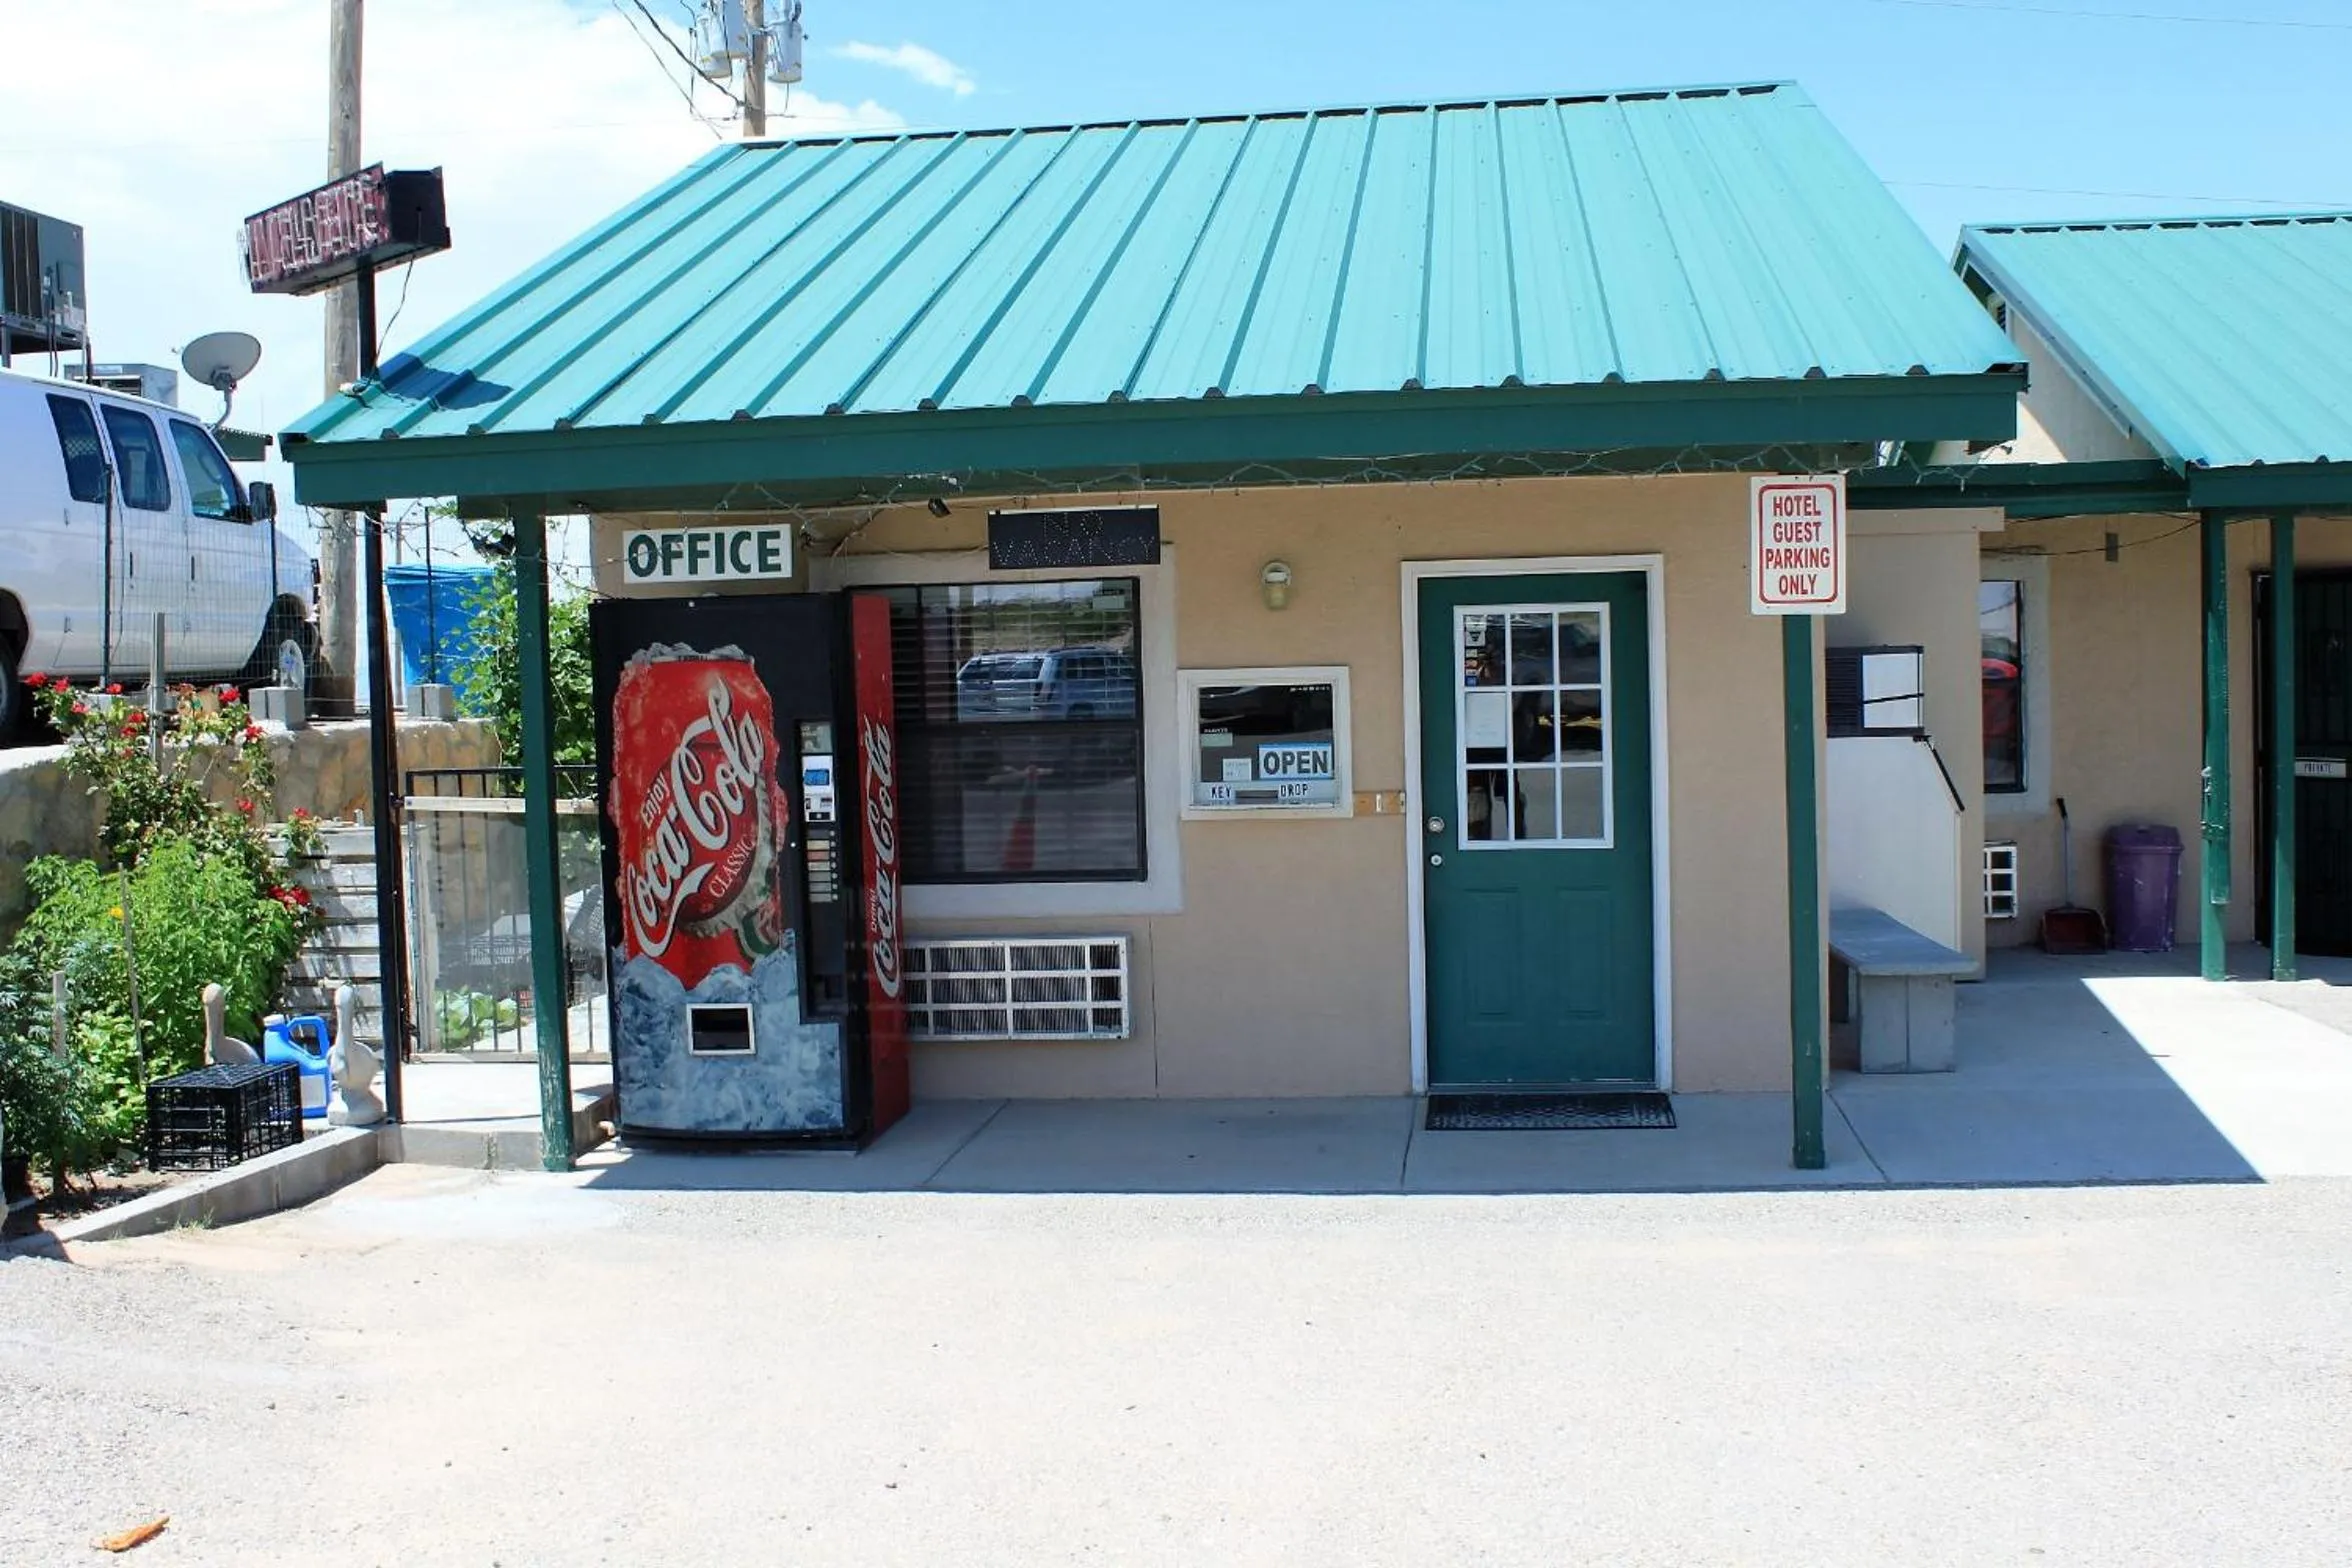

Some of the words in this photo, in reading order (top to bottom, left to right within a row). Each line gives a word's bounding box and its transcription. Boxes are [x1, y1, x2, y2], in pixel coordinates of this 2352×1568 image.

[1773, 495, 1821, 516] HOTEL
[1773, 522, 1821, 543] GUEST
[628, 530, 782, 578] OFFICE
[1765, 547, 1830, 569] PARKING
[1778, 574, 1817, 596] ONLY
[1262, 750, 1328, 775] OPEN
[640, 771, 671, 828] Enjoy
[1211, 785, 1232, 799] KEY
[1280, 783, 1309, 798] DROP
[709, 834, 754, 899] CLASSIC
